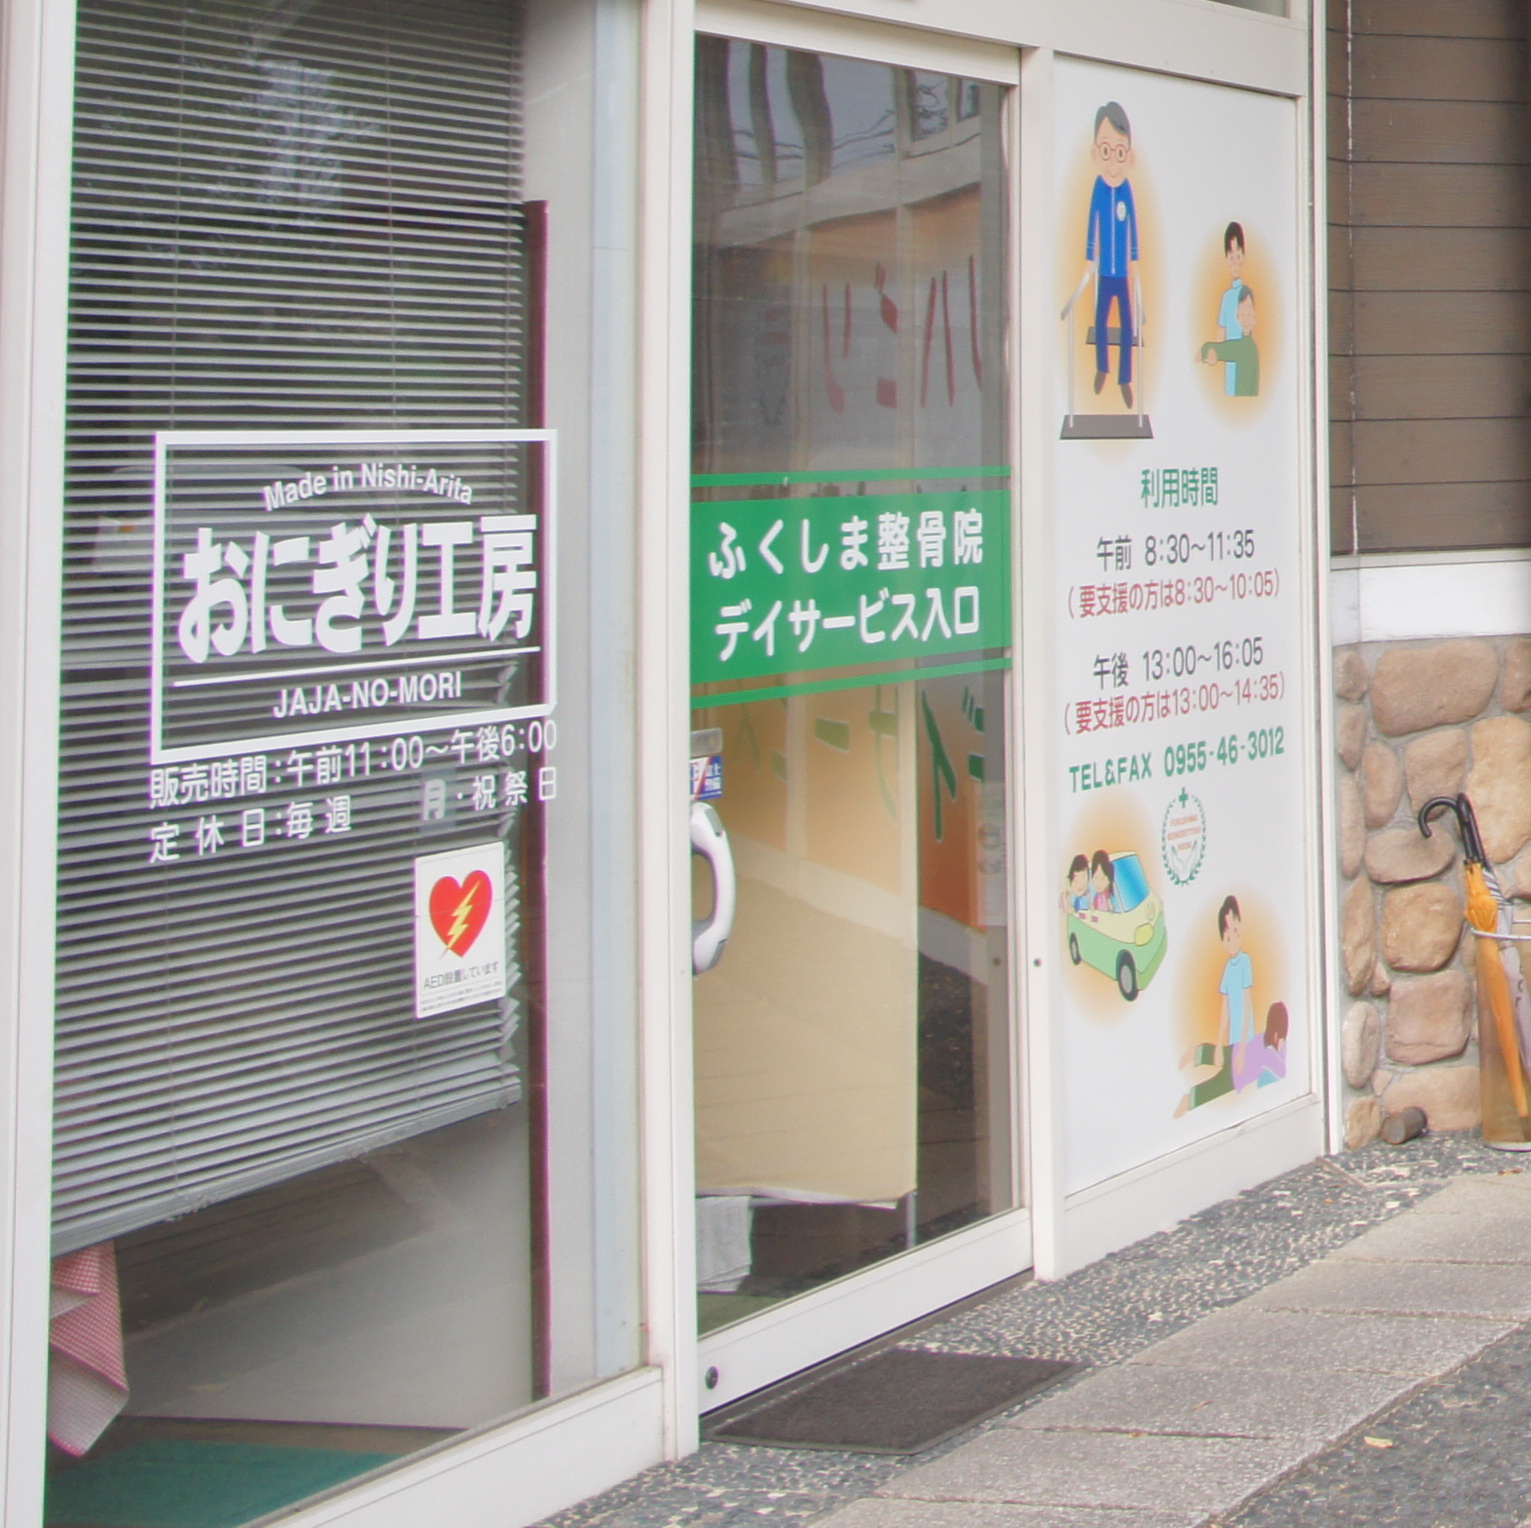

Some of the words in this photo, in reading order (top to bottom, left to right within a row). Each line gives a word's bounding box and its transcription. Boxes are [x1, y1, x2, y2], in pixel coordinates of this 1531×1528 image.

[263, 470, 327, 512] Made
[333, 465, 352, 491] in
[361, 462, 474, 506] Nishi-Arita
[1140, 466, 1219, 510] 利用時間
[708, 507, 984, 580] ふくしま整骨院
[1096, 534, 1132, 572] 午前
[1144, 528, 1256, 567] 8:30～11:35
[178, 511, 538, 664] おにぎり工房
[715, 585, 980, 662] デイサービス入口
[1093, 651, 1129, 691] 午後
[1142, 636, 1264, 682] 13:00～16:05
[273, 670, 463, 720] JAJA-NO-MORI
[1069, 751, 1153, 794] TEL&FAX
[1163, 725, 1285, 778] 0955-46-3012
